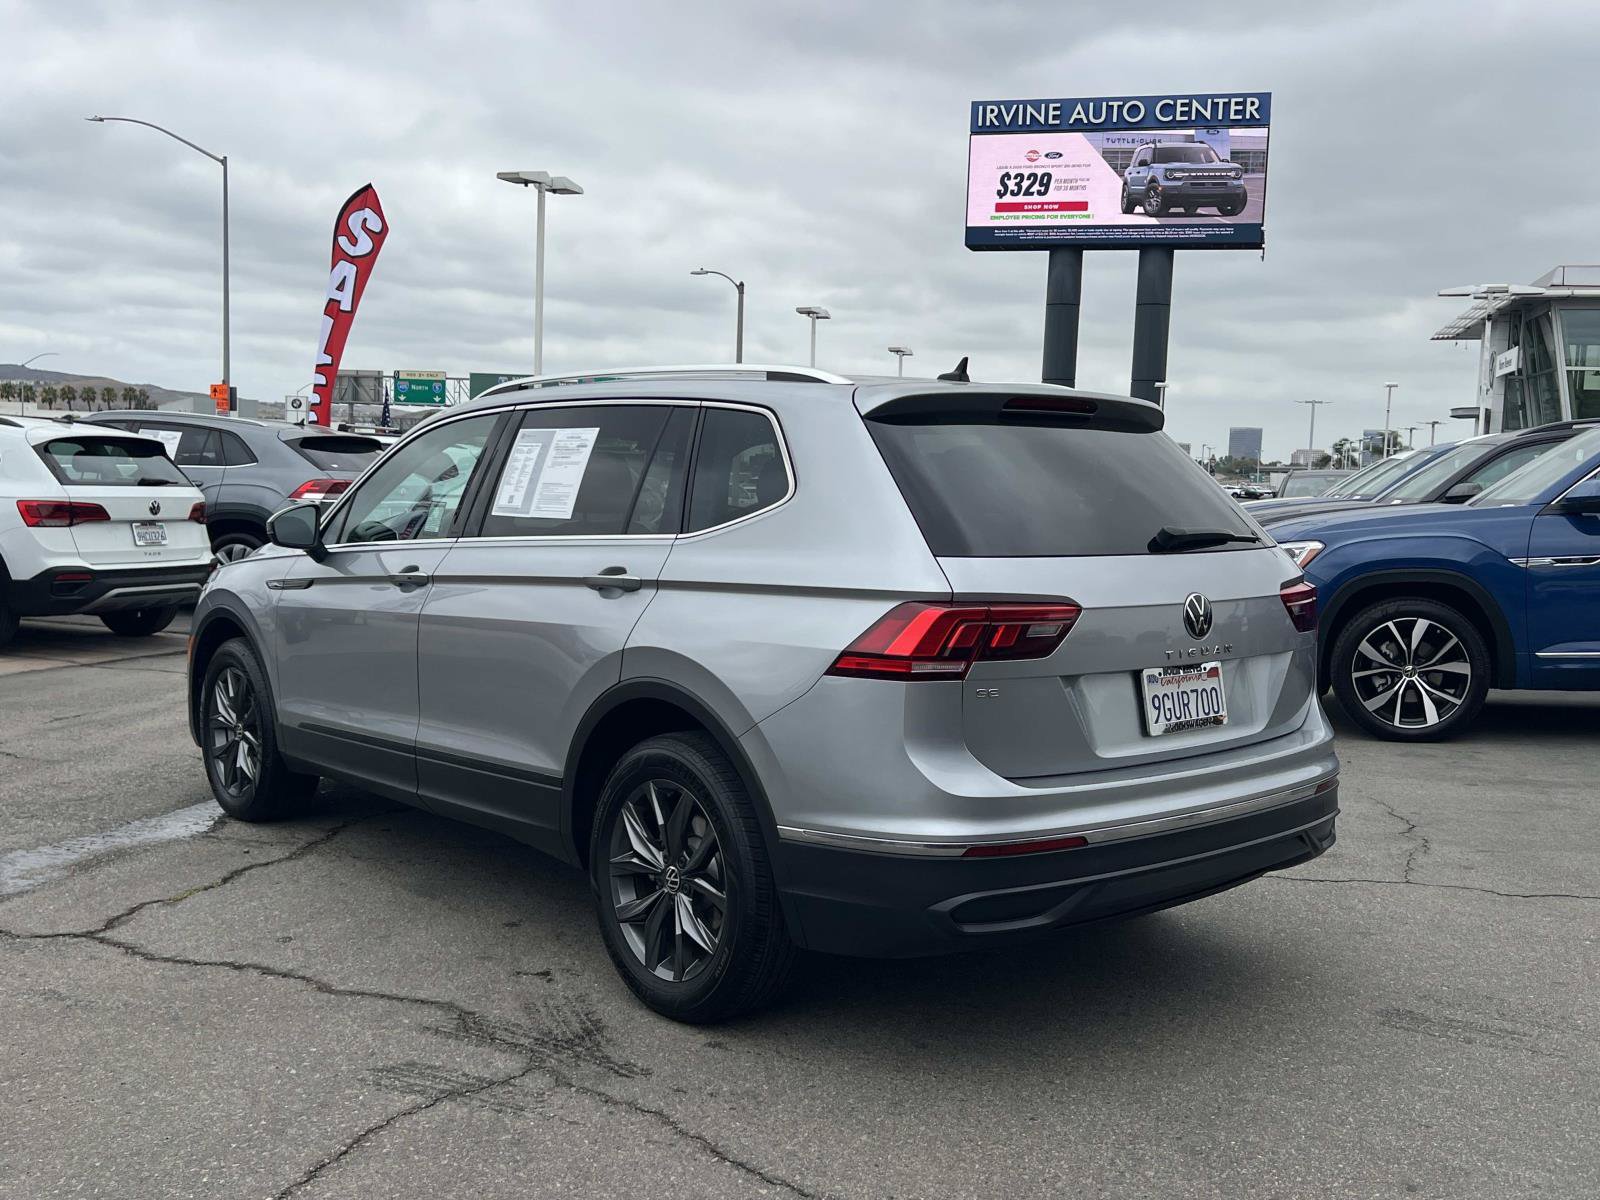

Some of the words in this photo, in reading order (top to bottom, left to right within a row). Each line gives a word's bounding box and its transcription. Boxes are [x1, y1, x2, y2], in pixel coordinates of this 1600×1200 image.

[976, 102, 1061, 127] IRVINE
[1068, 100, 1146, 125] AUTO
[1155, 97, 1262, 122] CENTER
[996, 171, 1053, 199] $329
[1165, 643, 1233, 660] TIGUAN
[1151, 686, 1221, 724] 9GUR700
